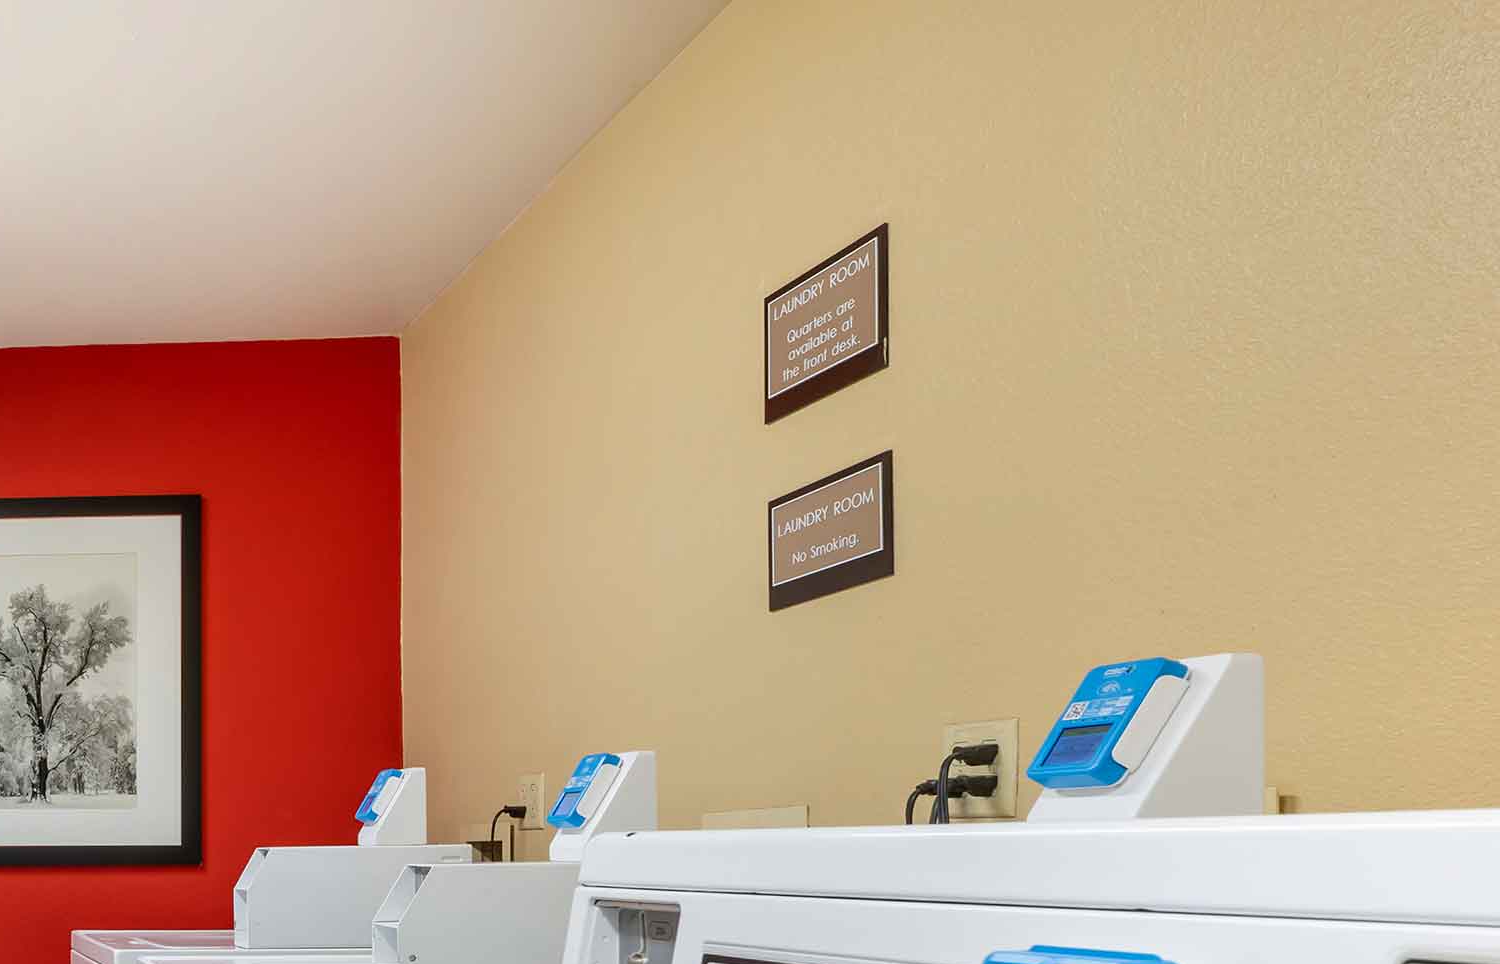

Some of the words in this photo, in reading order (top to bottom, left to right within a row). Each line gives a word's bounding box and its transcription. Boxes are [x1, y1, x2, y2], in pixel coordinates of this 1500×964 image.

[773, 280, 824, 321] LAUNDRY
[830, 254, 870, 288] ROOM
[787, 310, 833, 343] Quarters
[837, 298, 855, 317] are
[788, 327, 836, 361] available
[842, 316, 853, 332] at
[782, 366, 799, 382] the
[803, 350, 827, 370] front
[832, 335, 861, 355] desk.
[778, 506, 828, 537] LAUNDRY
[834, 488, 874, 516] ROOM
[792, 553, 807, 564] No
[810, 533, 859, 558] Smoking.
